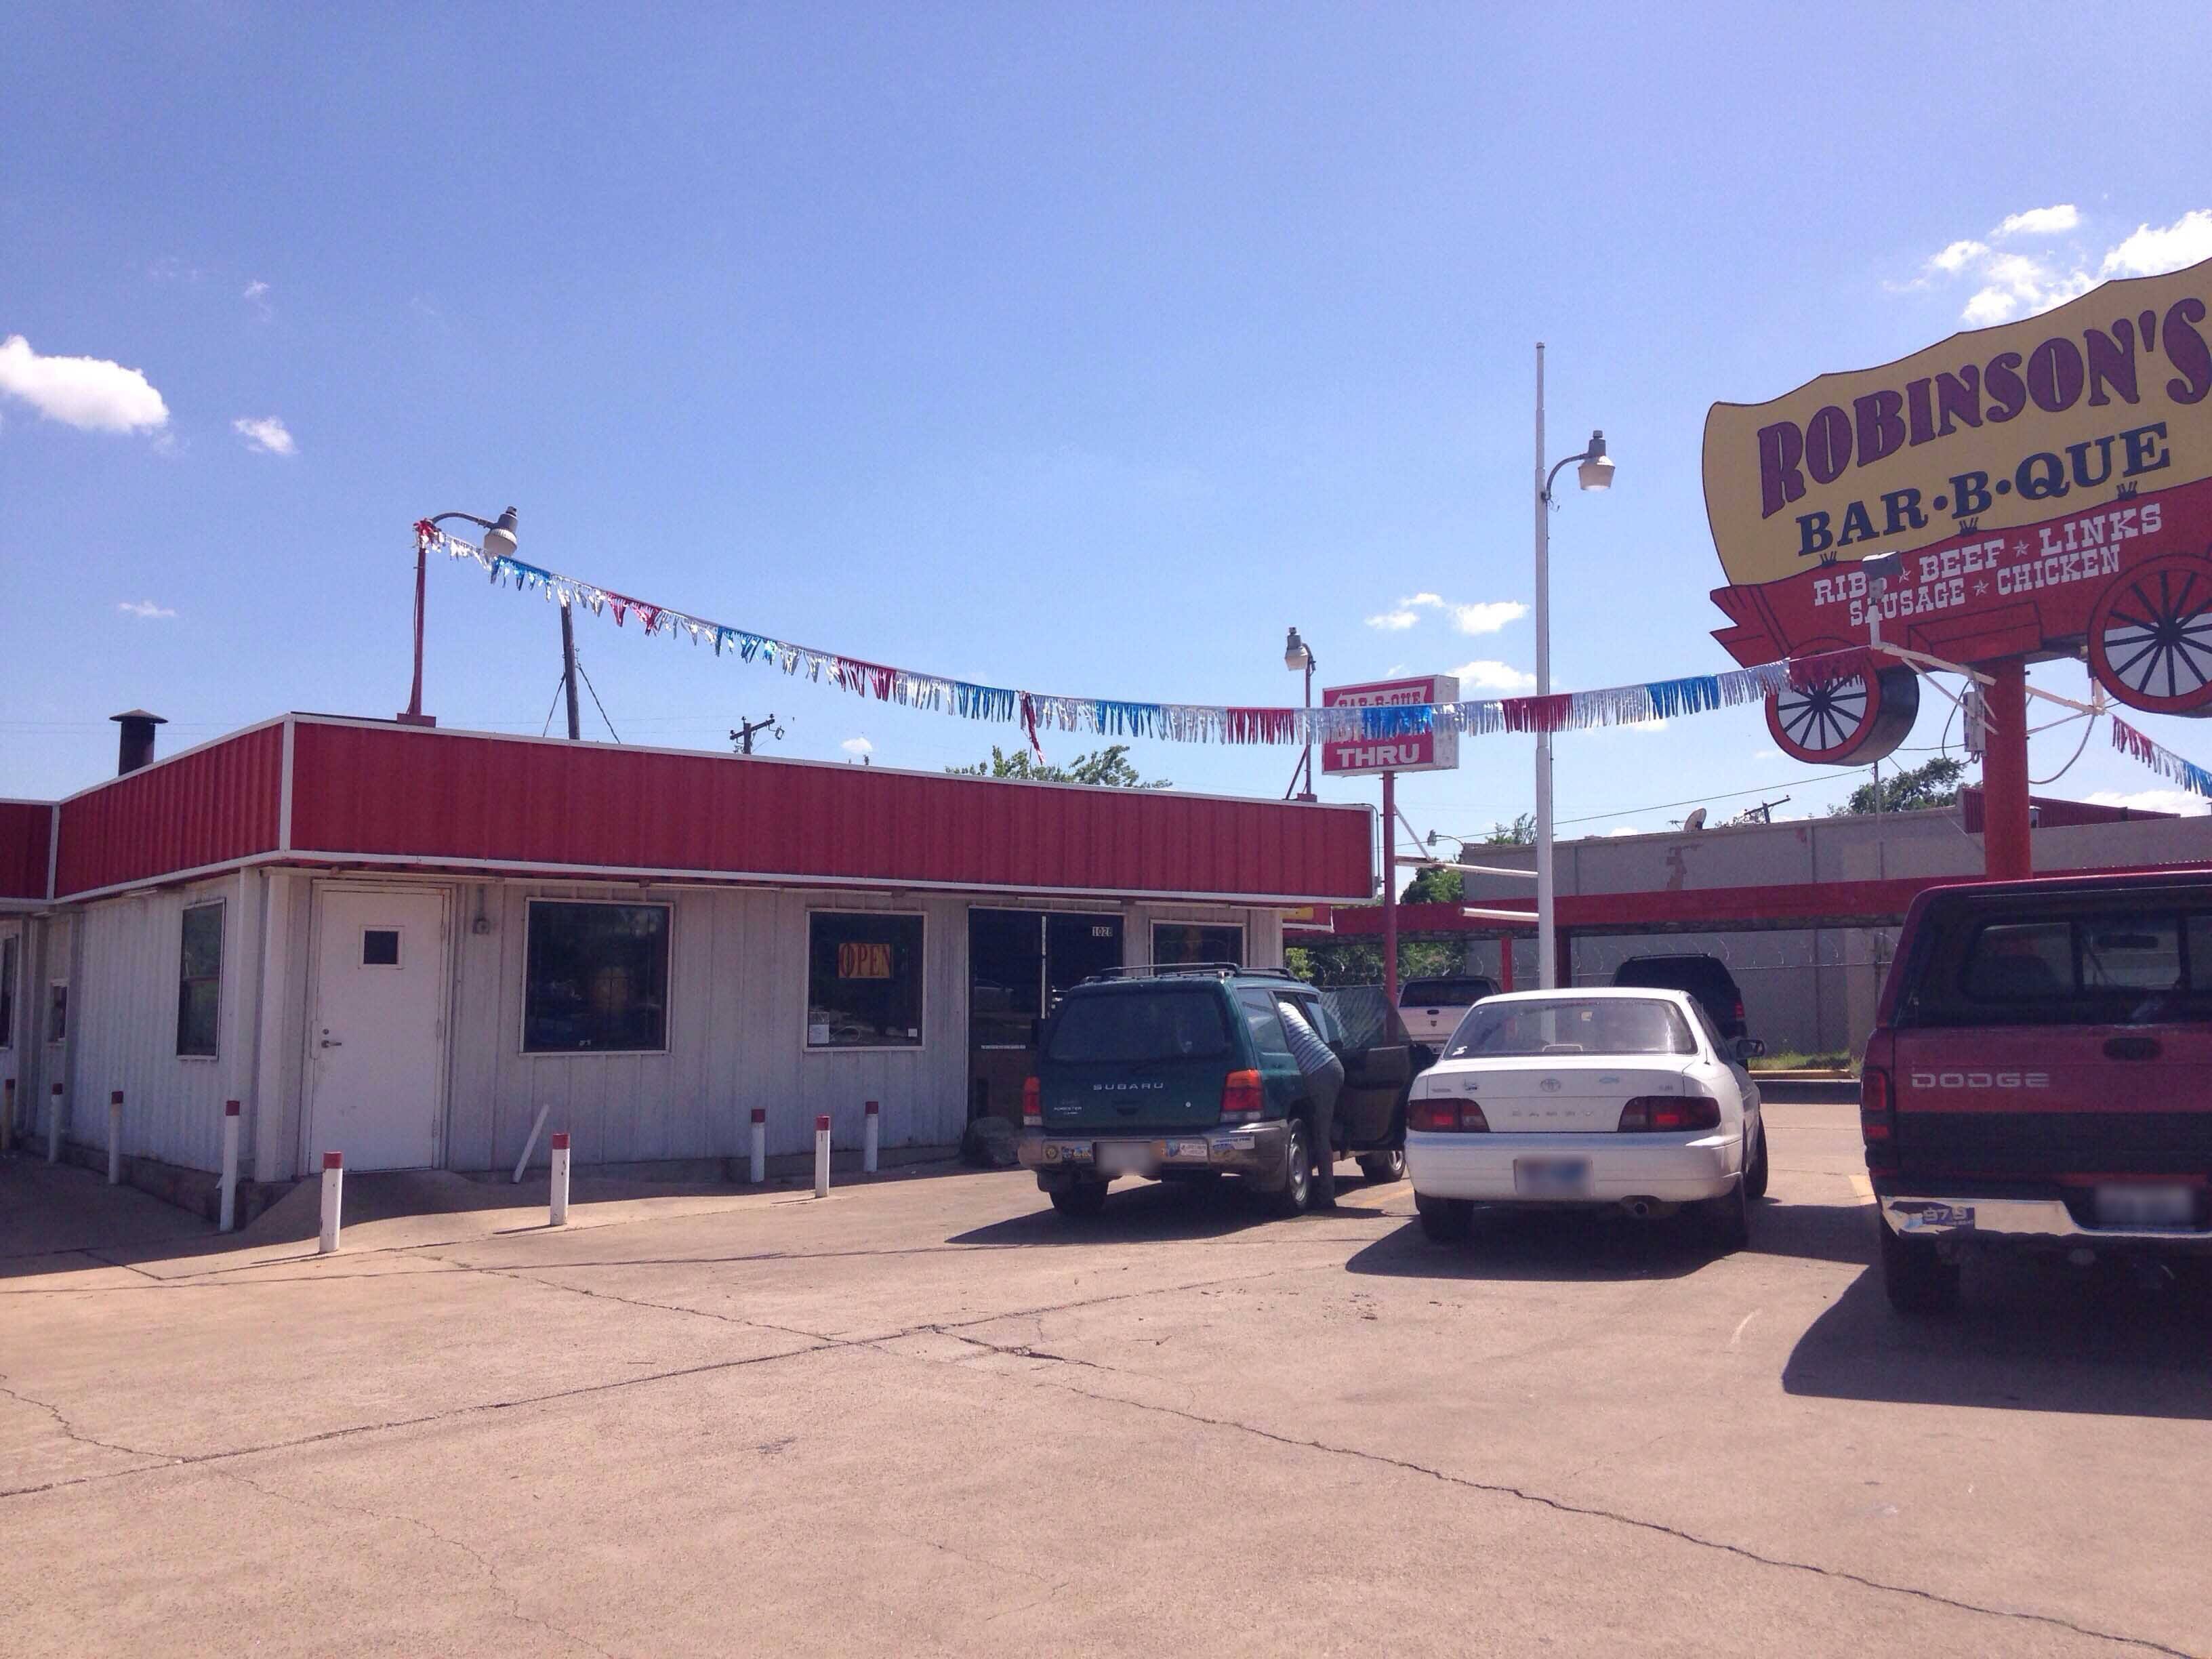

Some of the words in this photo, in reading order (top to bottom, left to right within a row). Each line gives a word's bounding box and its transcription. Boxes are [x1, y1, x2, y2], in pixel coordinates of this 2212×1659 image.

[1757, 298, 2212, 519] ROBINSON'S
[1814, 571, 1887, 607] RIB
[1919, 539, 2004, 583] BEEF
[2039, 504, 2162, 557] LINKS
[1996, 544, 2120, 595] CHICKEN
[1337, 744, 1419, 767] THRU
[839, 943, 890, 977] OPEN
[1912, 1073, 2049, 1087] DODGE
